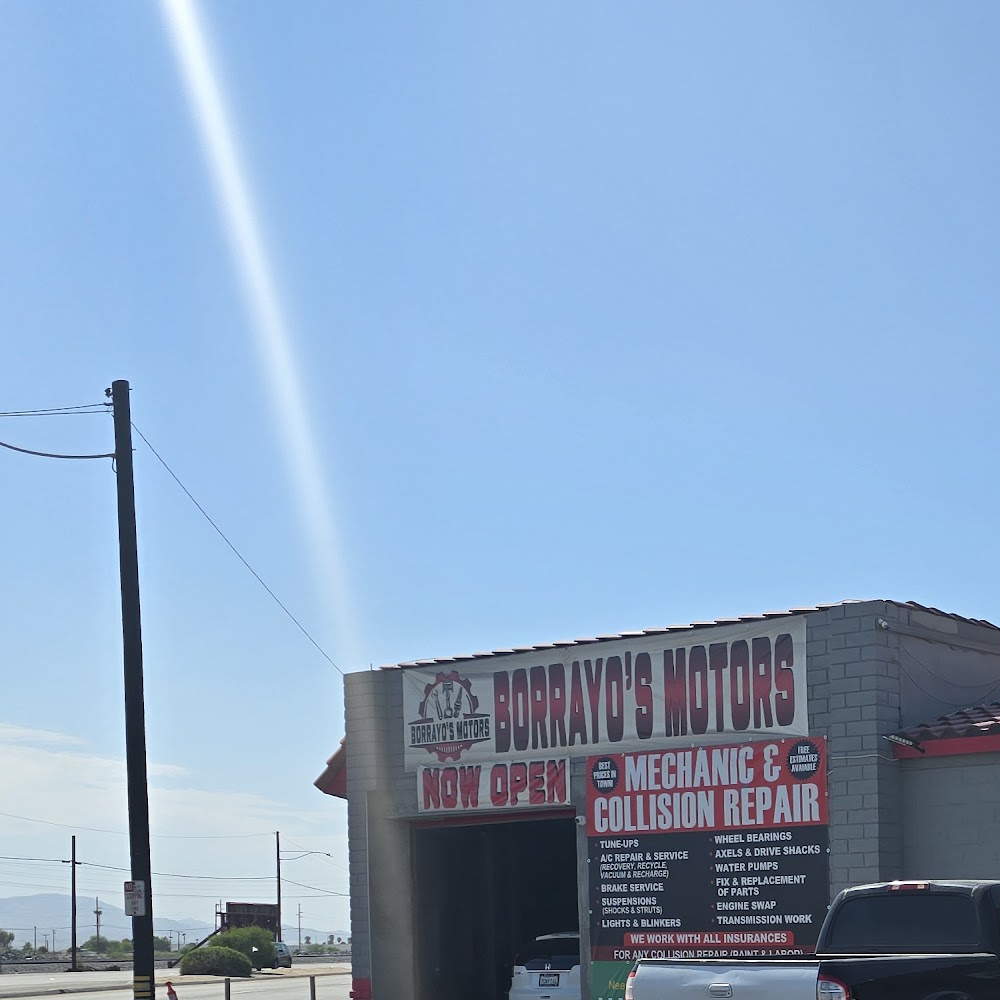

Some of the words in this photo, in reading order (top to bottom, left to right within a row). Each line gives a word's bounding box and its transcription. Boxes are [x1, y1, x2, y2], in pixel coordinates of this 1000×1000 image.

[493, 651, 653, 753] BORRAYO'S
[663, 633, 795, 737] MOTORS
[411, 722, 454, 744] BORRAYO'S
[457, 718, 489, 739] MOTORS
[798, 745, 810, 754] FREE
[790, 754, 818, 763] ESTIMATES
[599, 761, 610, 770] BEST
[625, 747, 753, 792] MECHANIC
[763, 744, 781, 782] &
[593, 771, 610, 779] PRICES
[611, 770, 616, 778] IN
[422, 766, 481, 810] NOW
[489, 759, 566, 807] OPEN
[594, 791, 715, 833] COLLISION
[723, 783, 820, 826] REPAIR
[715, 834, 744, 844] WHEEL
[747, 832, 792, 842] BEARINGS
[600, 839, 639, 848] TUNE-UPS
[601, 854, 613, 862] A/C
[615, 853, 643, 862] REPAIR
[646, 852, 651, 860] &
[654, 851, 689, 860] SERVICE
[715, 849, 743, 858] AXELS
[745, 848, 752, 857] &
[754, 847, 781, 856] DRIVE
[783, 845, 821, 855] SHACKS
[600, 862, 636, 871] (RECOVERY,
[637, 861, 667, 870] RECYCLE,
[715, 862, 746, 872] WATER
[748, 861, 778, 871] PUMPS
[600, 871, 626, 879] VACUUM
[633, 870, 669, 879] RECHARGE)
[716, 877, 730, 886] FIX
[732, 877, 739, 886] &
[741, 875, 806, 886] REPLACEMENT
[601, 884, 628, 892] BRAKE
[630, 883, 664, 891] SERVICE
[718, 888, 729, 896] OF
[731, 887, 759, 896] PARTS
[602, 897, 656, 906] SUSPENSIONS
[717, 902, 749, 910] ENGINE
[751, 901, 776, 909] SWAP
[602, 907, 629, 915] (SHOCKS
[636, 906, 662, 915] STRUTS)
[602, 919, 630, 928] LIGHTS
[633, 919, 639, 927] &
[641, 919, 681, 927] BLINKERS
[717, 915, 782, 924] TRANSMISSION
[784, 914, 812, 923] WORK
[631, 934, 645, 944] WE
[647, 934, 674, 943] WORK
[676, 934, 701, 943] WITH
[703, 934, 721, 943] ALL
[724, 933, 787, 943] INSURANCES
[614, 950, 630, 959] FOR
[632, 950, 649, 959] ANY
[651, 950, 694, 958] COLLISION
[608, 980, 625, 990] Nee
